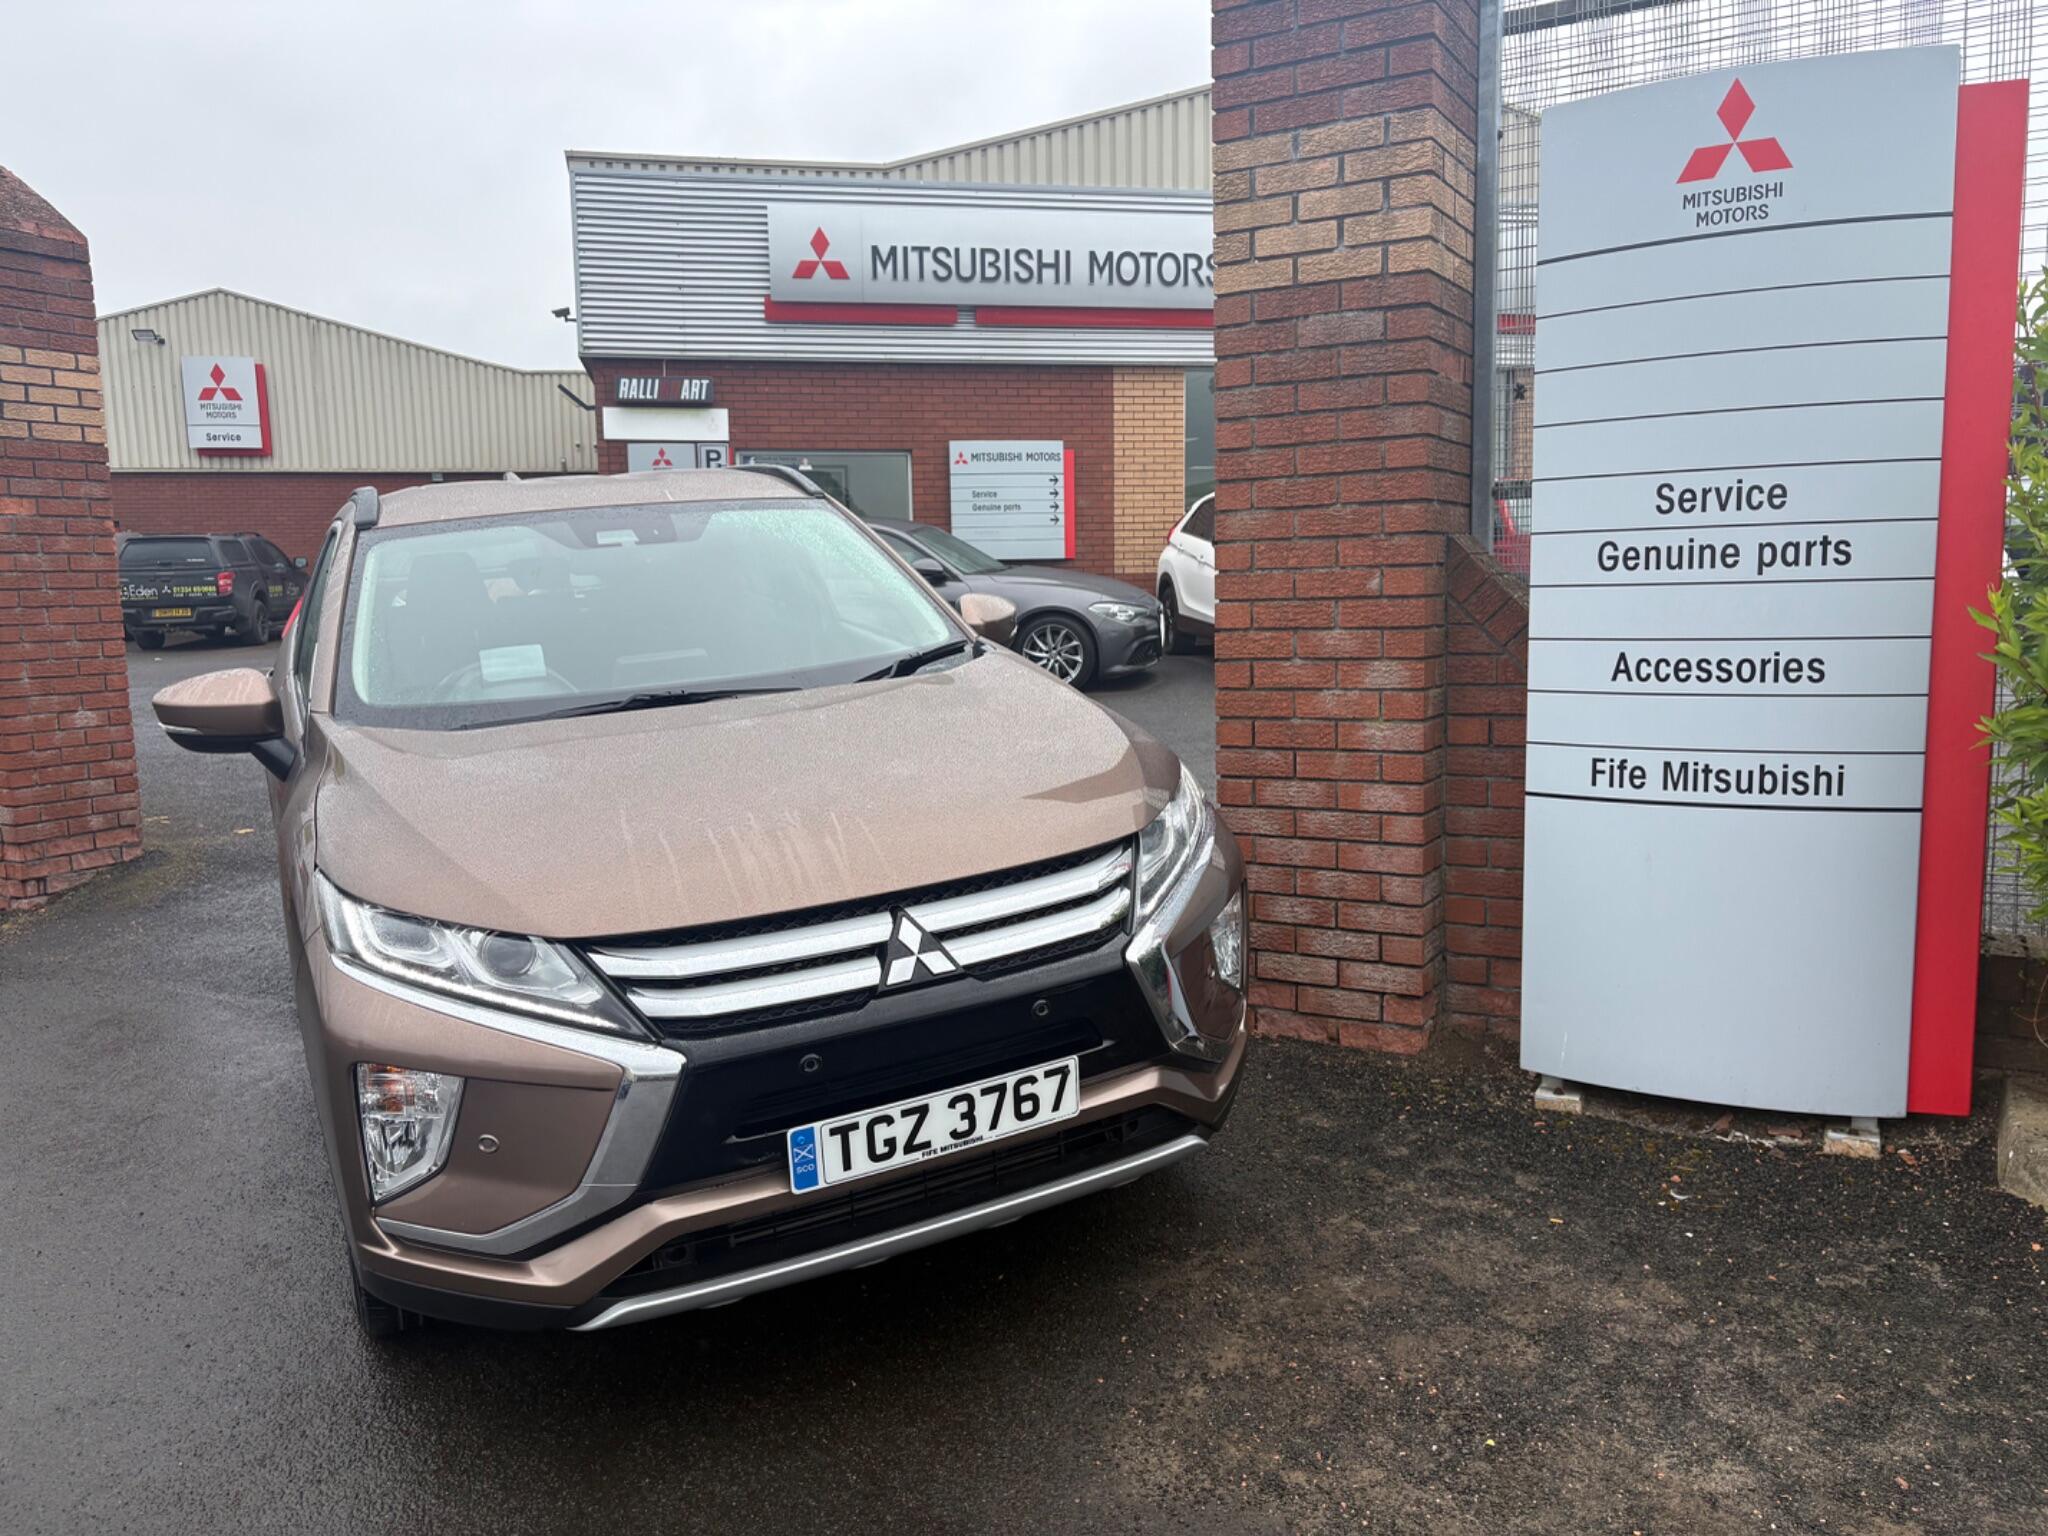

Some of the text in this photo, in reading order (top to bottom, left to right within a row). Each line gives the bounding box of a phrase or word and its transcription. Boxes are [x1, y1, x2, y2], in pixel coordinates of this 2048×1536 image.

[1683, 182, 1784, 210] MITSUBISHI
[1696, 204, 1769, 227] MOTORS
[871, 244, 1072, 286] MITSUBISHI
[619, 377, 710, 400] RALLI ART
[200, 403, 242, 411] MITSUBISHI
[206, 411, 237, 419] MOTORS
[206, 432, 242, 442] Service
[706, 449, 722, 469] P
[971, 452, 1061, 462] MITSUBISHI MOTORS
[972, 490, 998, 498] Service
[1655, 479, 1788, 514] Service
[972, 503, 1021, 513] Genuine parts
[1597, 534, 1853, 576] Genuine parts
[129, 584, 158, 597] Eden
[1611, 651, 1826, 684] Accessories
[1591, 757, 1846, 797] Fife Mitsubishi
[829, 1064, 1071, 1172] TGZ 3767
[922, 1135, 984, 1159] FIFE MITSUBISHI
[796, 1163, 816, 1174] SCO
